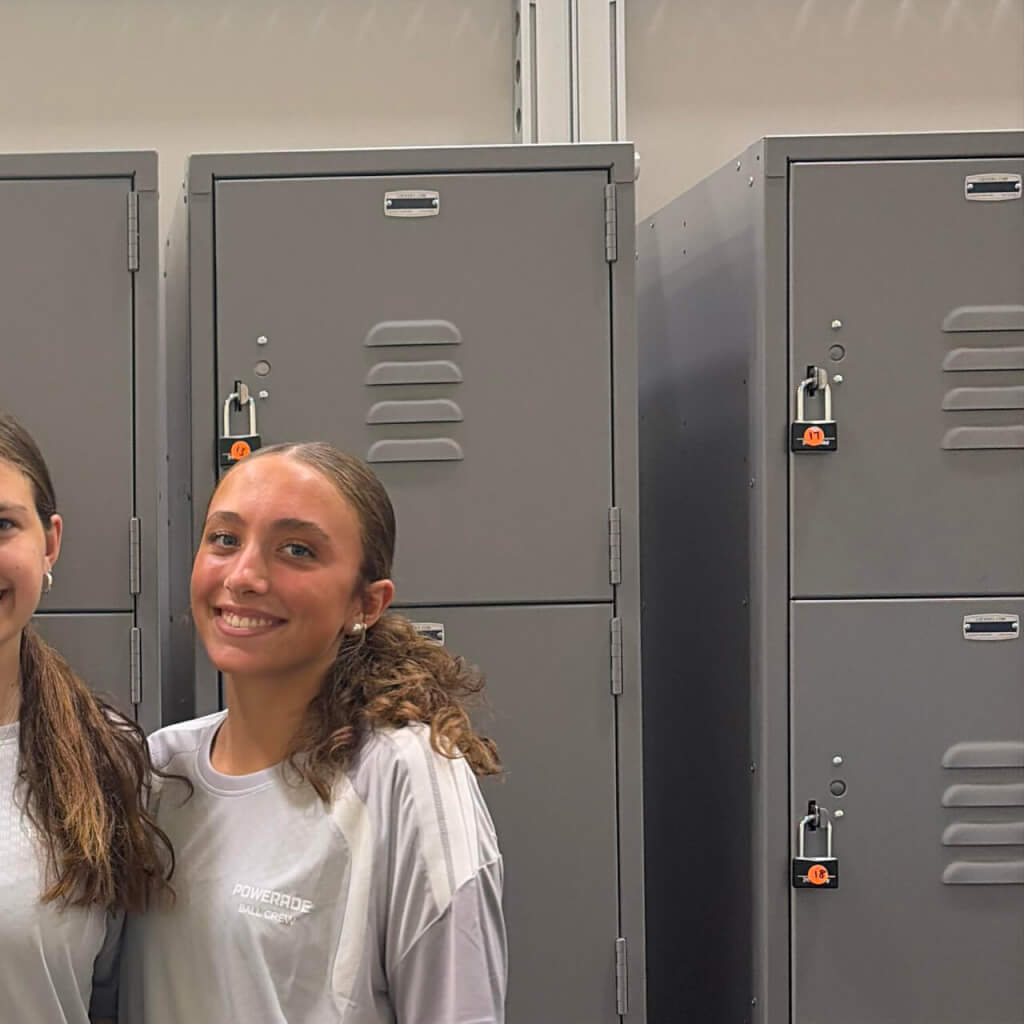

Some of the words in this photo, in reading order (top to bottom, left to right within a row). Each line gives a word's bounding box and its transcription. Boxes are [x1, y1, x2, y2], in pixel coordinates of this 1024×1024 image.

[808, 431, 821, 441] 17
[814, 868, 826, 879] 18
[232, 883, 314, 913] POWERADE
[263, 910, 297, 926] CREW
